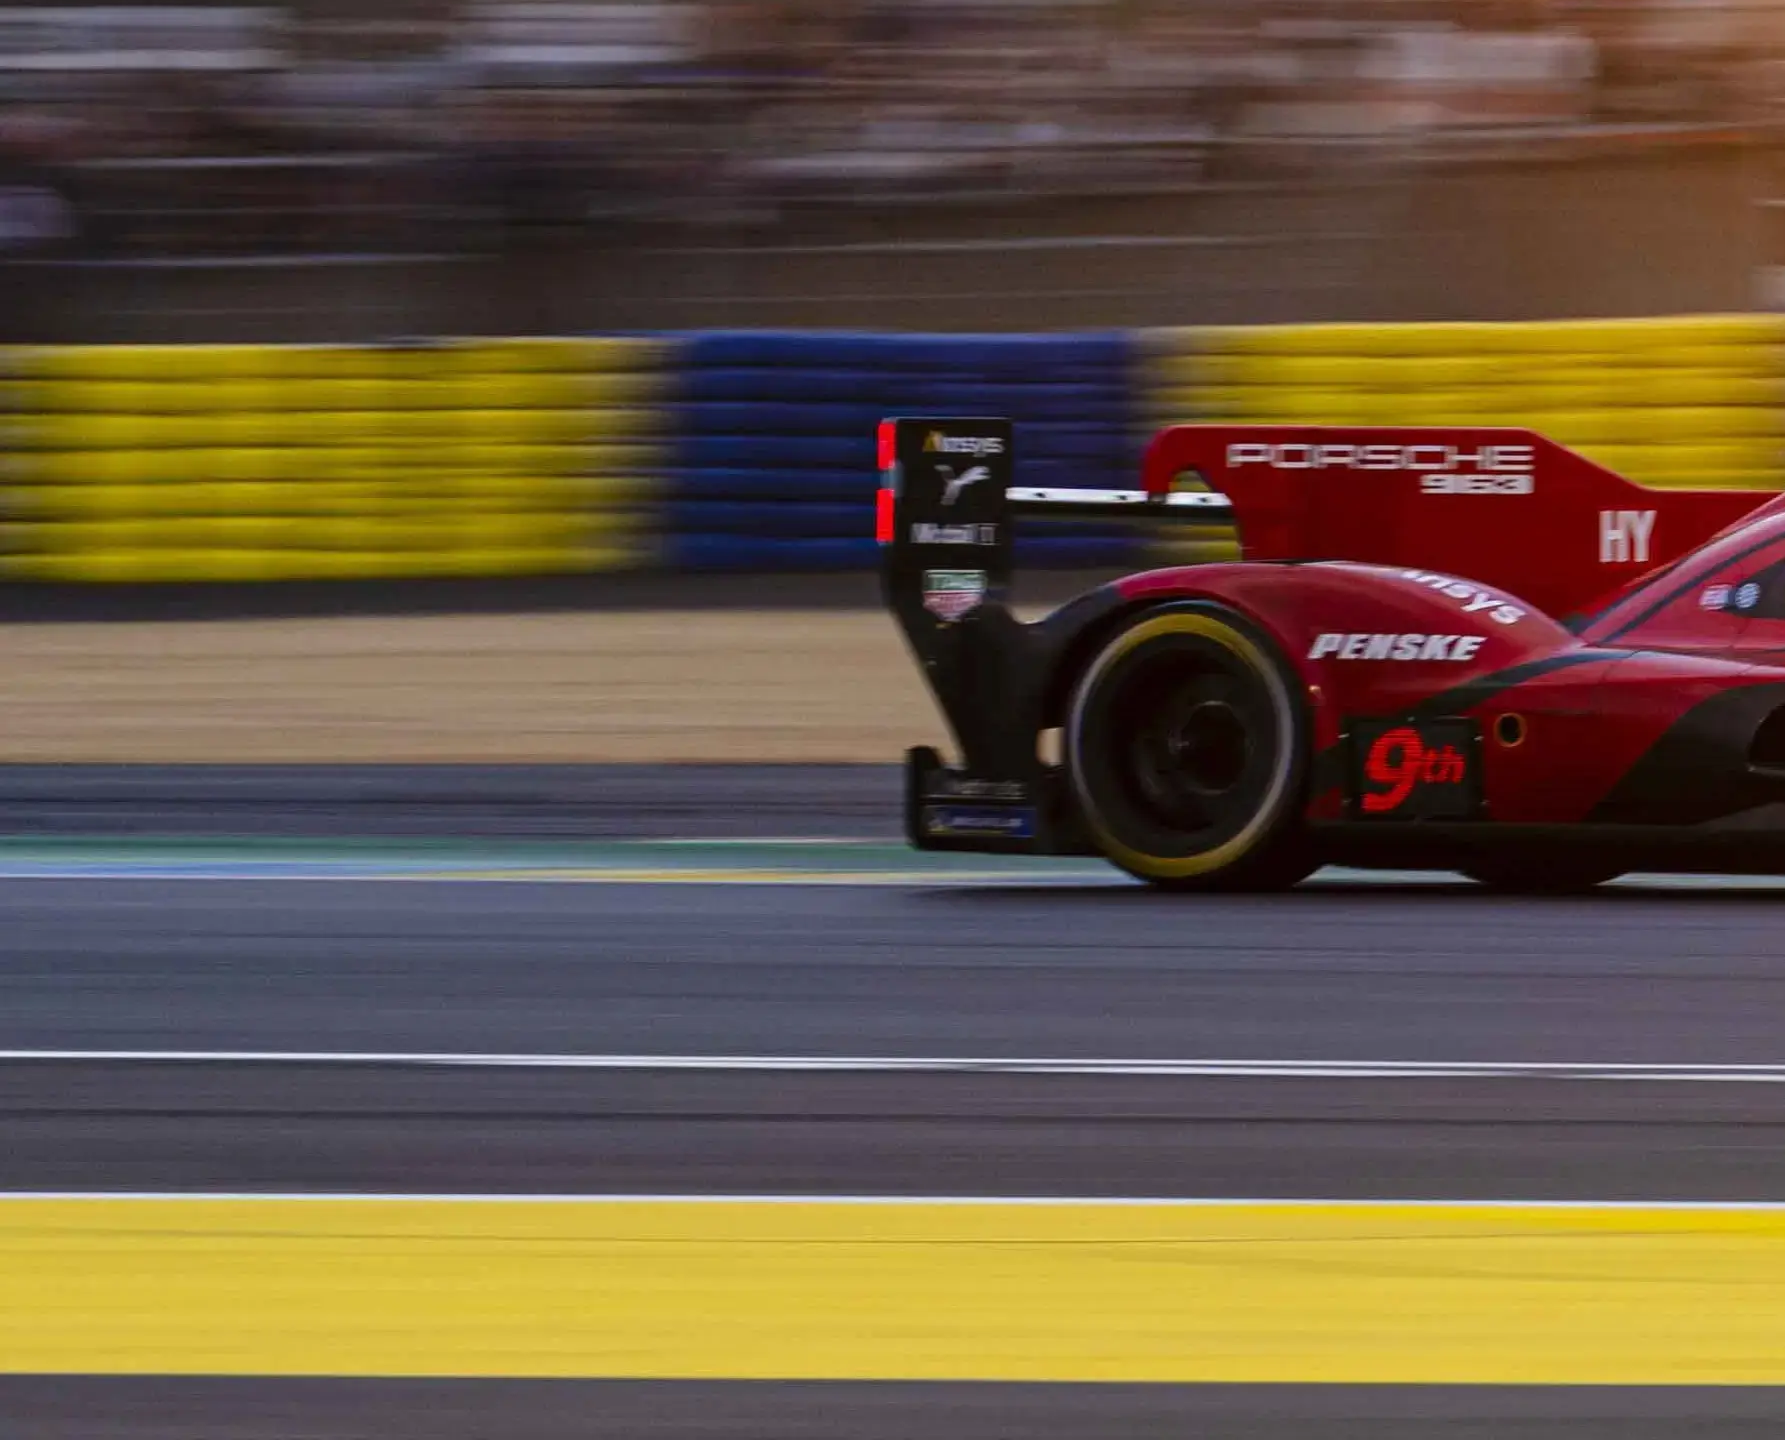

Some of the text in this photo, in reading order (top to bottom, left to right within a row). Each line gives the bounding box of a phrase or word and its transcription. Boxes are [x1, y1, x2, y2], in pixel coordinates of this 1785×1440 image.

[1226, 443, 1535, 470] PORSCHE
[1420, 474, 1535, 495] 963
[1600, 511, 1656, 563] HY
[1307, 633, 1488, 661] PENSKE
[1361, 726, 1466, 812] 9th
